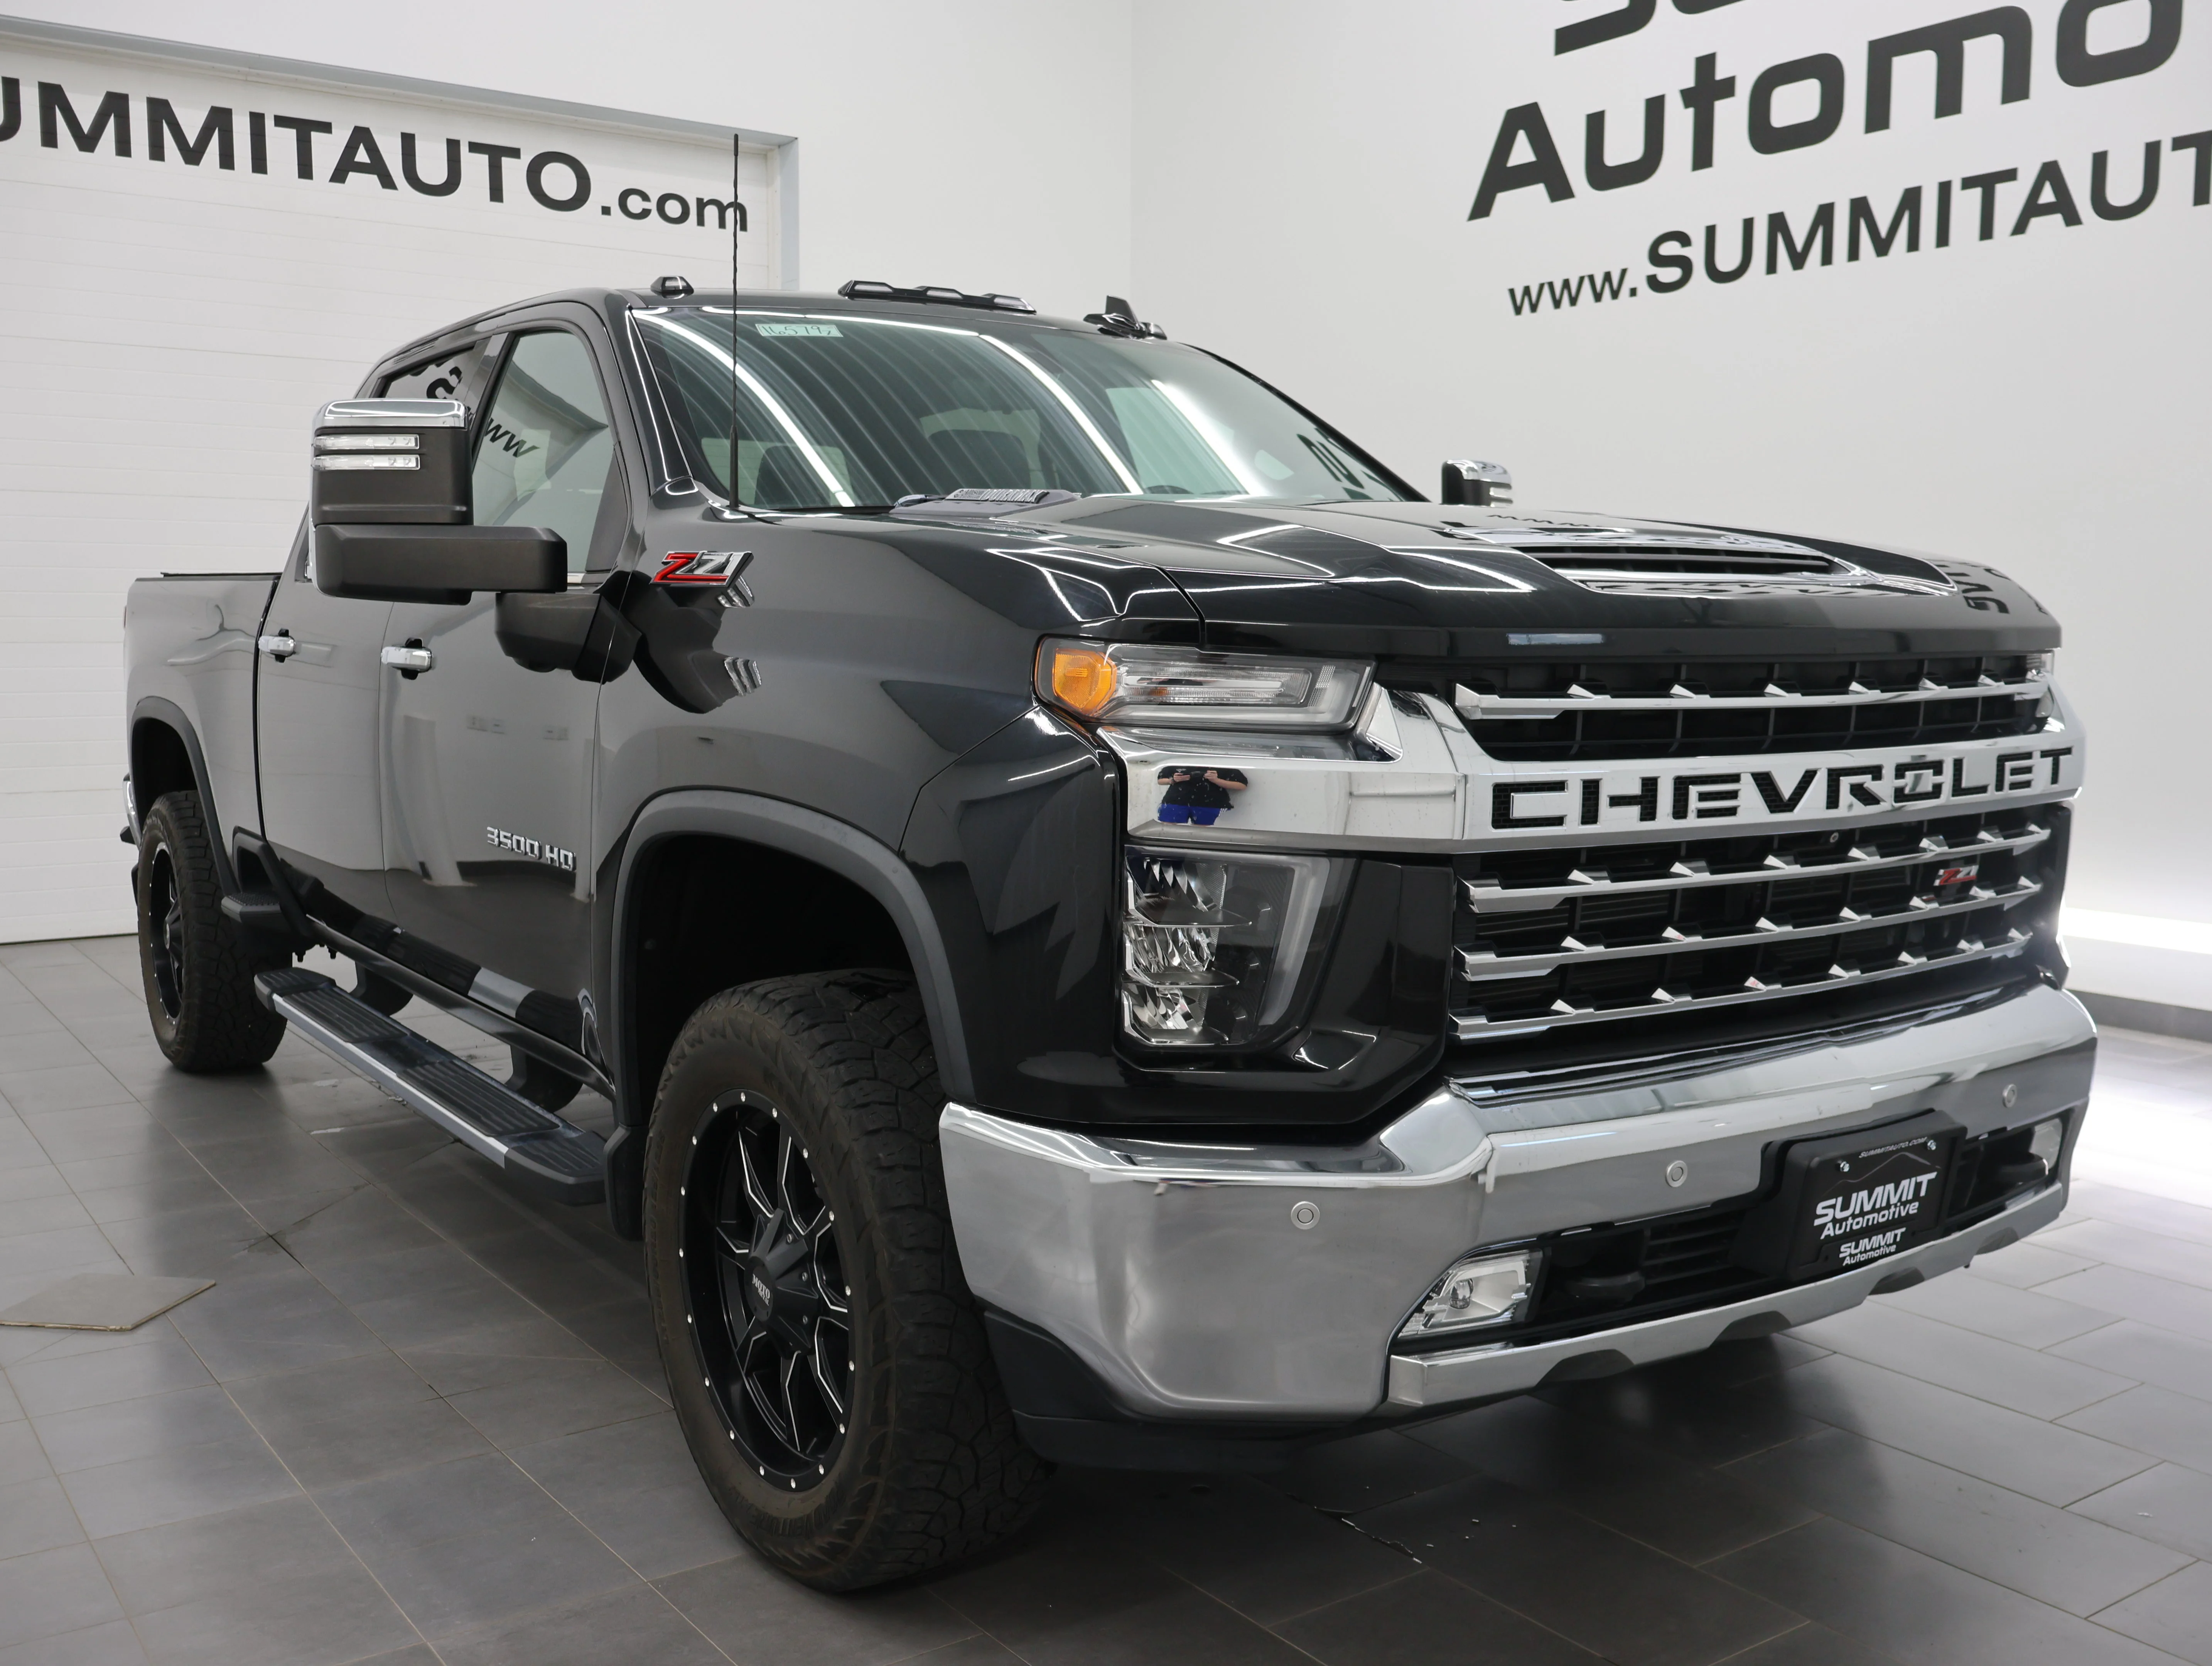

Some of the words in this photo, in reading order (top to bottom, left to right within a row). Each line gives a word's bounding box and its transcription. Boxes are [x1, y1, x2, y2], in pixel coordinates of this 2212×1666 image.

[649, 550, 754, 587] Z71
[1490, 745, 2074, 831] CHEVROLET
[487, 826, 542, 860] 3500
[545, 844, 577, 872] HD
[1934, 865, 1979, 886] Z71
[1814, 1171, 1937, 1226] SUMMIT
[1820, 1201, 1919, 1240] Automotive
[1839, 1227, 1906, 1258] SUMMIT
[1842, 1244, 1896, 1266] Automotive
[752, 1273, 771, 1299] MOTO
